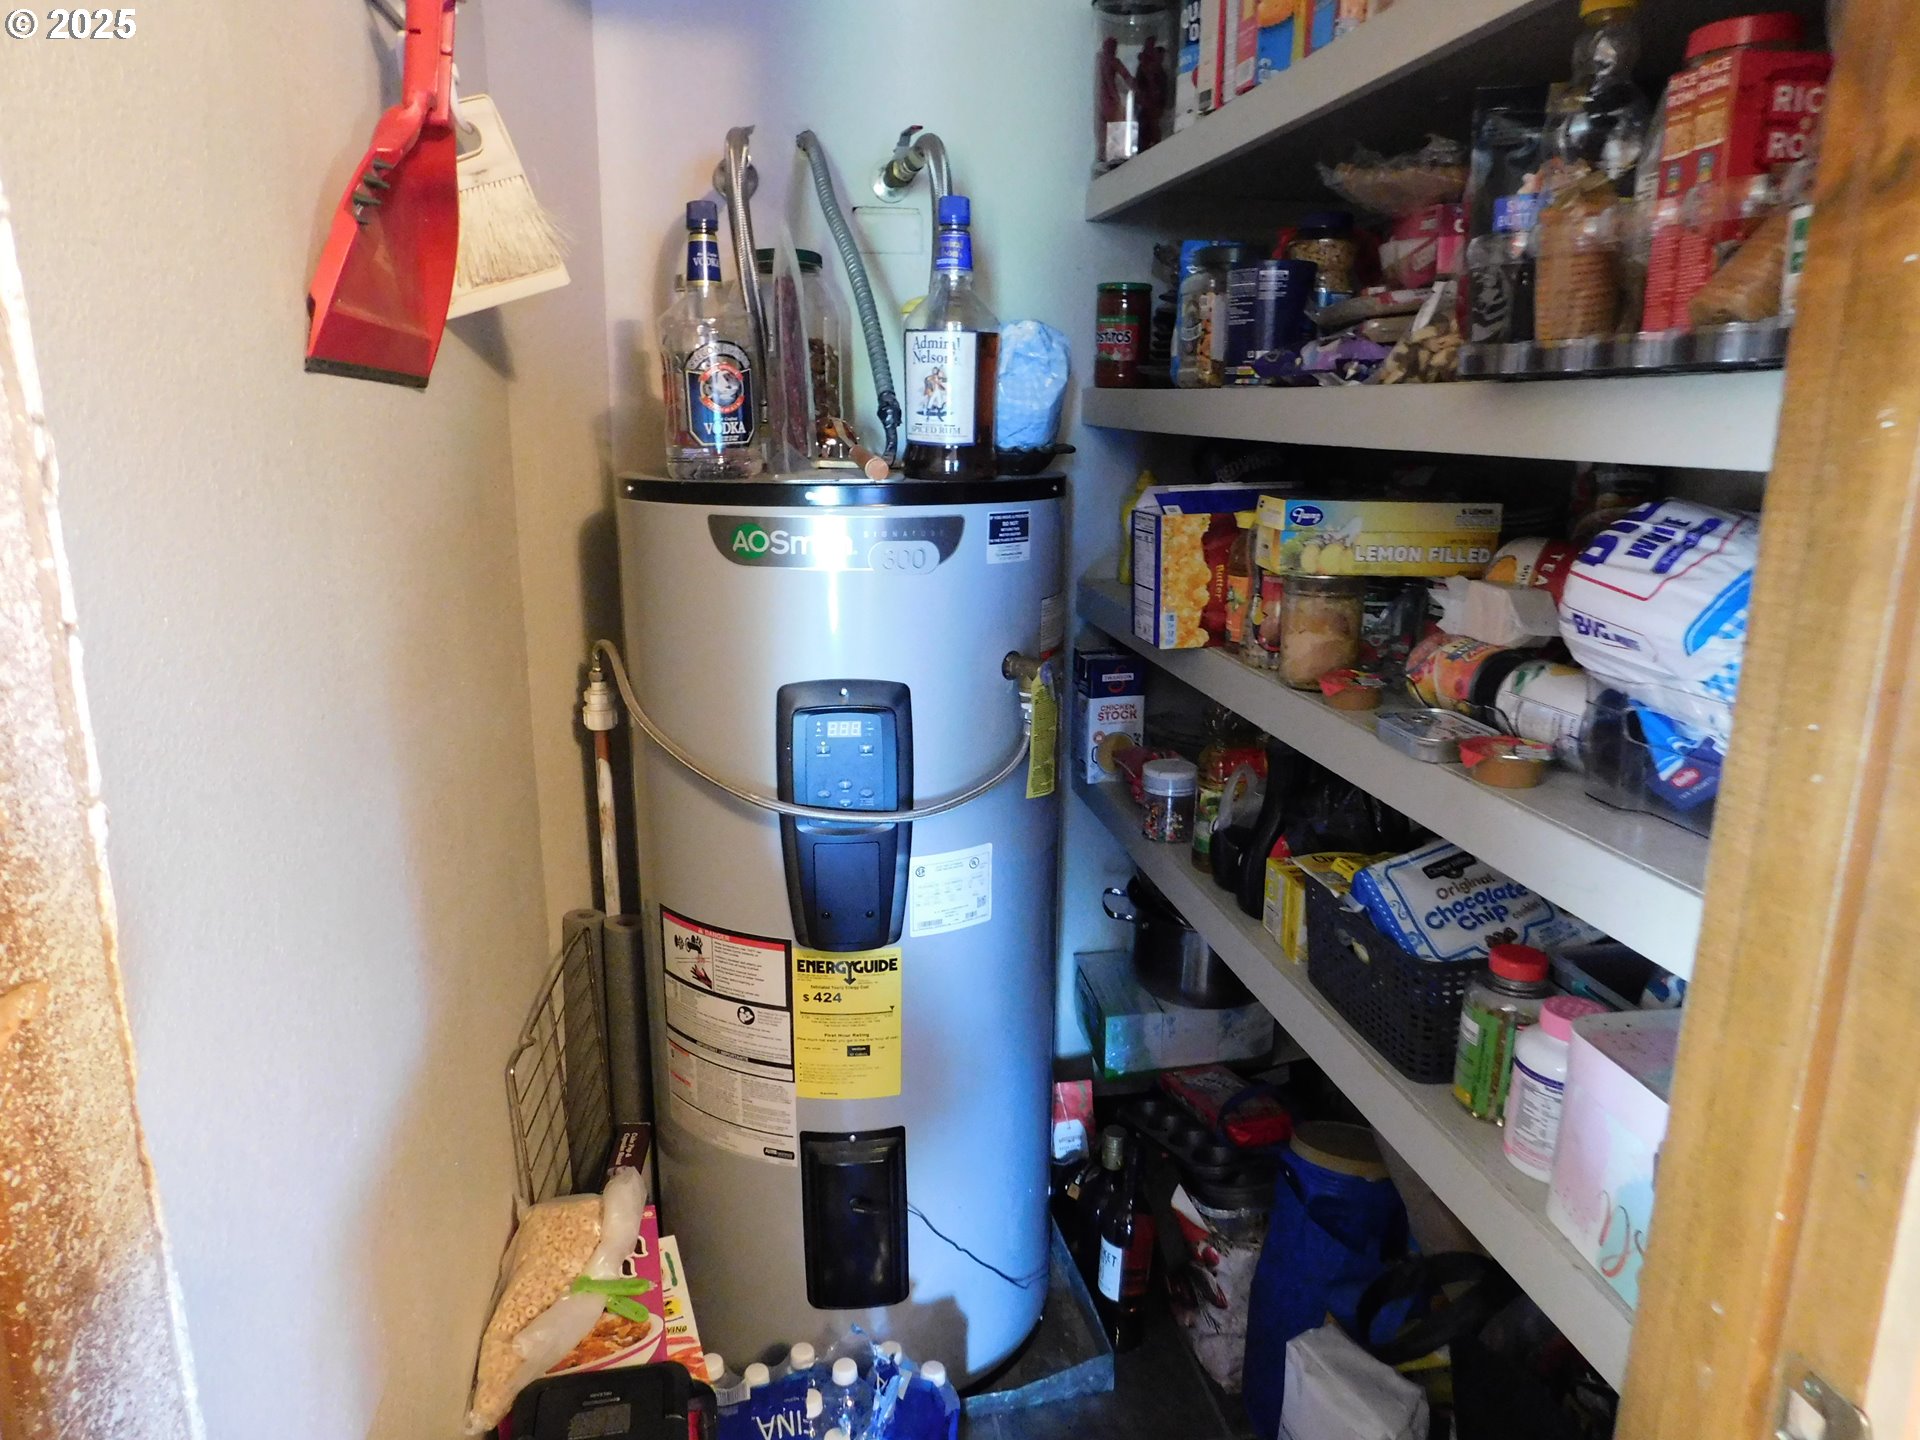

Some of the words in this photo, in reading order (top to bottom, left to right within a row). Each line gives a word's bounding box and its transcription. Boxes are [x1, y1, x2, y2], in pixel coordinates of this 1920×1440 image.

[692, 256, 720, 268] VODKA
[704, 420, 746, 435] VODKA
[938, 426, 961, 435] RUM
[732, 530, 852, 556] AOSmh
[1354, 545, 1422, 564] LEMON
[1427, 547, 1491, 565] FILLED
[1215, 563, 1226, 602] Butter
[1097, 709, 1138, 722] STOCK
[1100, 703, 1136, 712] CHICKEN
[1436, 873, 1496, 900] Original
[1424, 881, 1530, 930] Chocolate
[1457, 904, 1509, 931] Chip
[796, 957, 899, 985] ENERGYGUIDE
[813, 991, 843, 1003] 424
